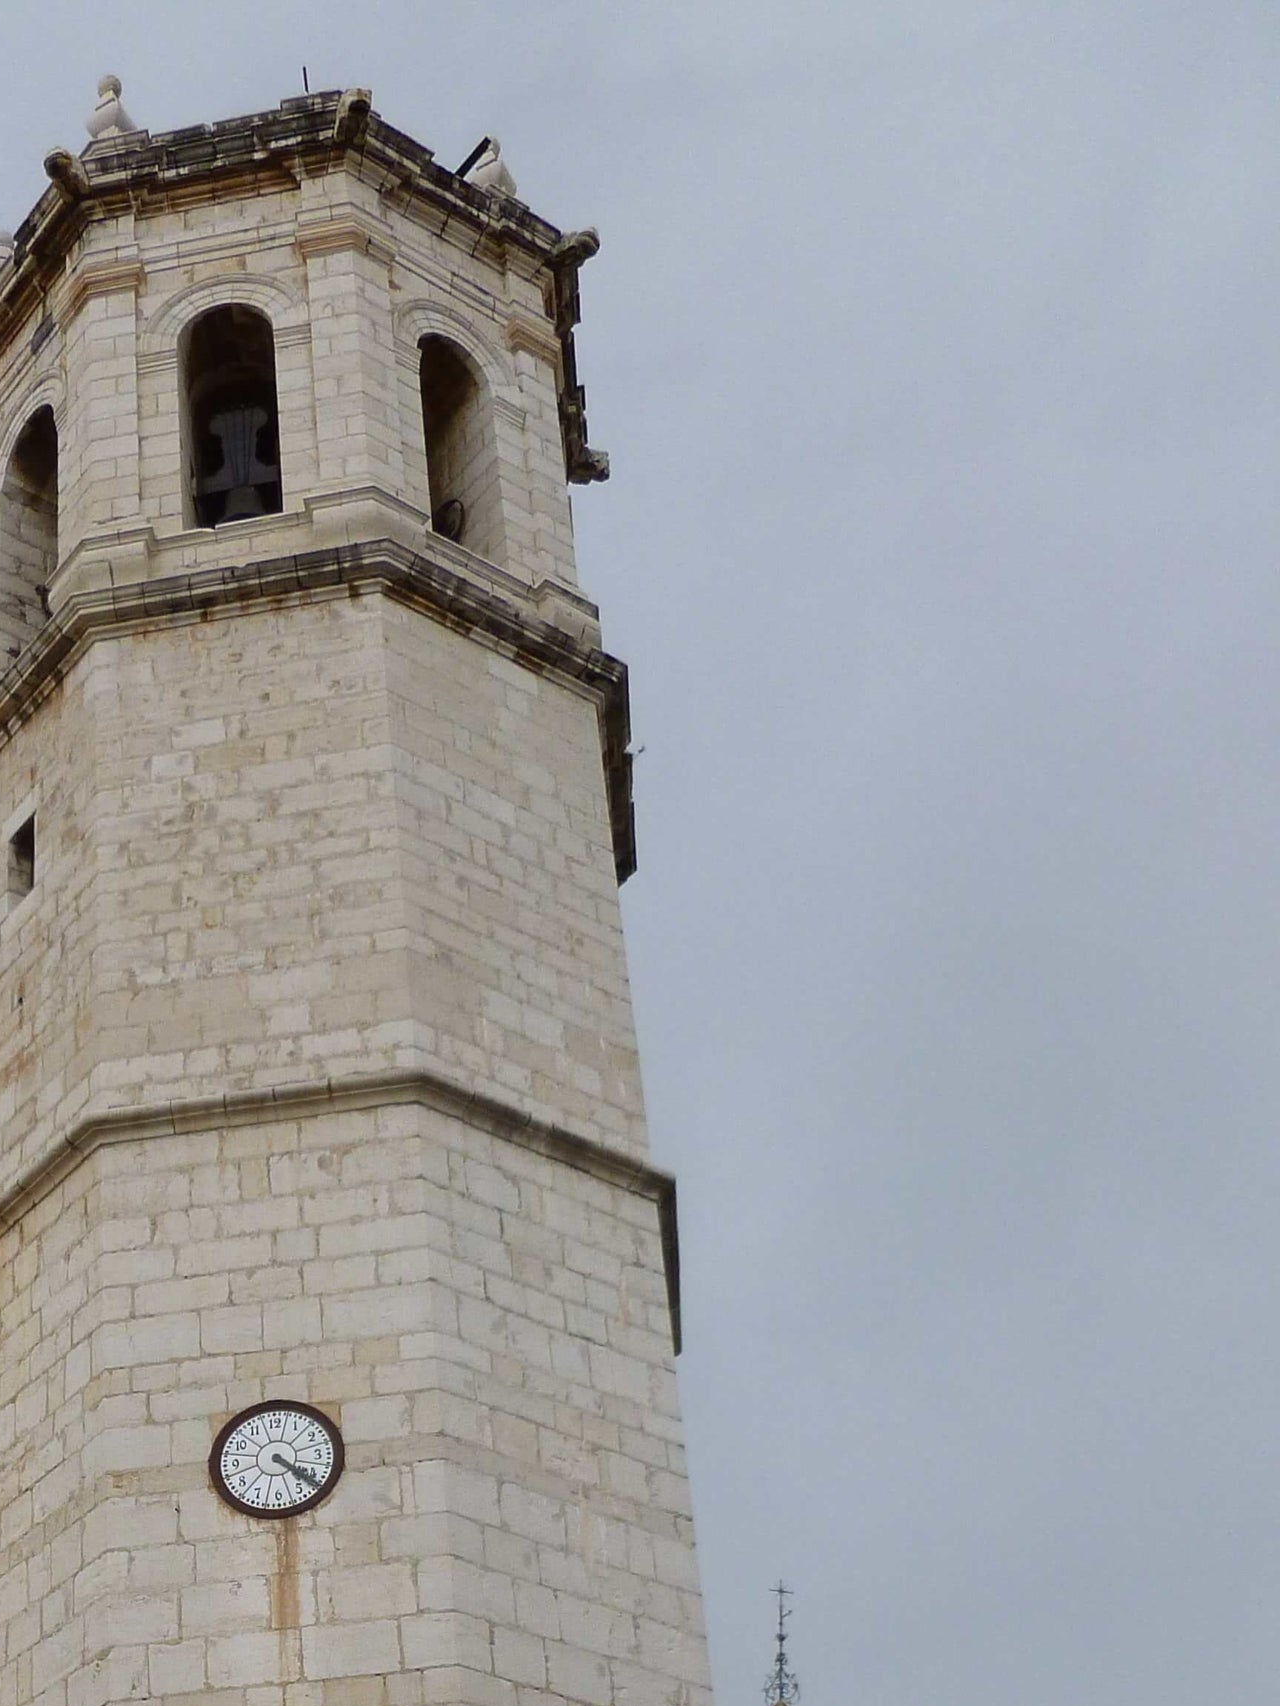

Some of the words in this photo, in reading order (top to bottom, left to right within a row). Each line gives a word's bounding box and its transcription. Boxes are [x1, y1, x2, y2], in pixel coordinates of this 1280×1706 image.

[269, 1418, 281, 1429] 12
[293, 1421, 297, 1431] 1
[250, 1425, 259, 1436] 11
[308, 1432, 315, 1442] 2
[236, 1440, 247, 1451] 10
[314, 1449, 322, 1459] 3
[232, 1459, 239, 1469] 9
[238, 1476, 246, 1486] 8
[254, 1488, 261, 1499] 7
[295, 1483, 302, 1494] 5
[275, 1489, 282, 1500] 6
